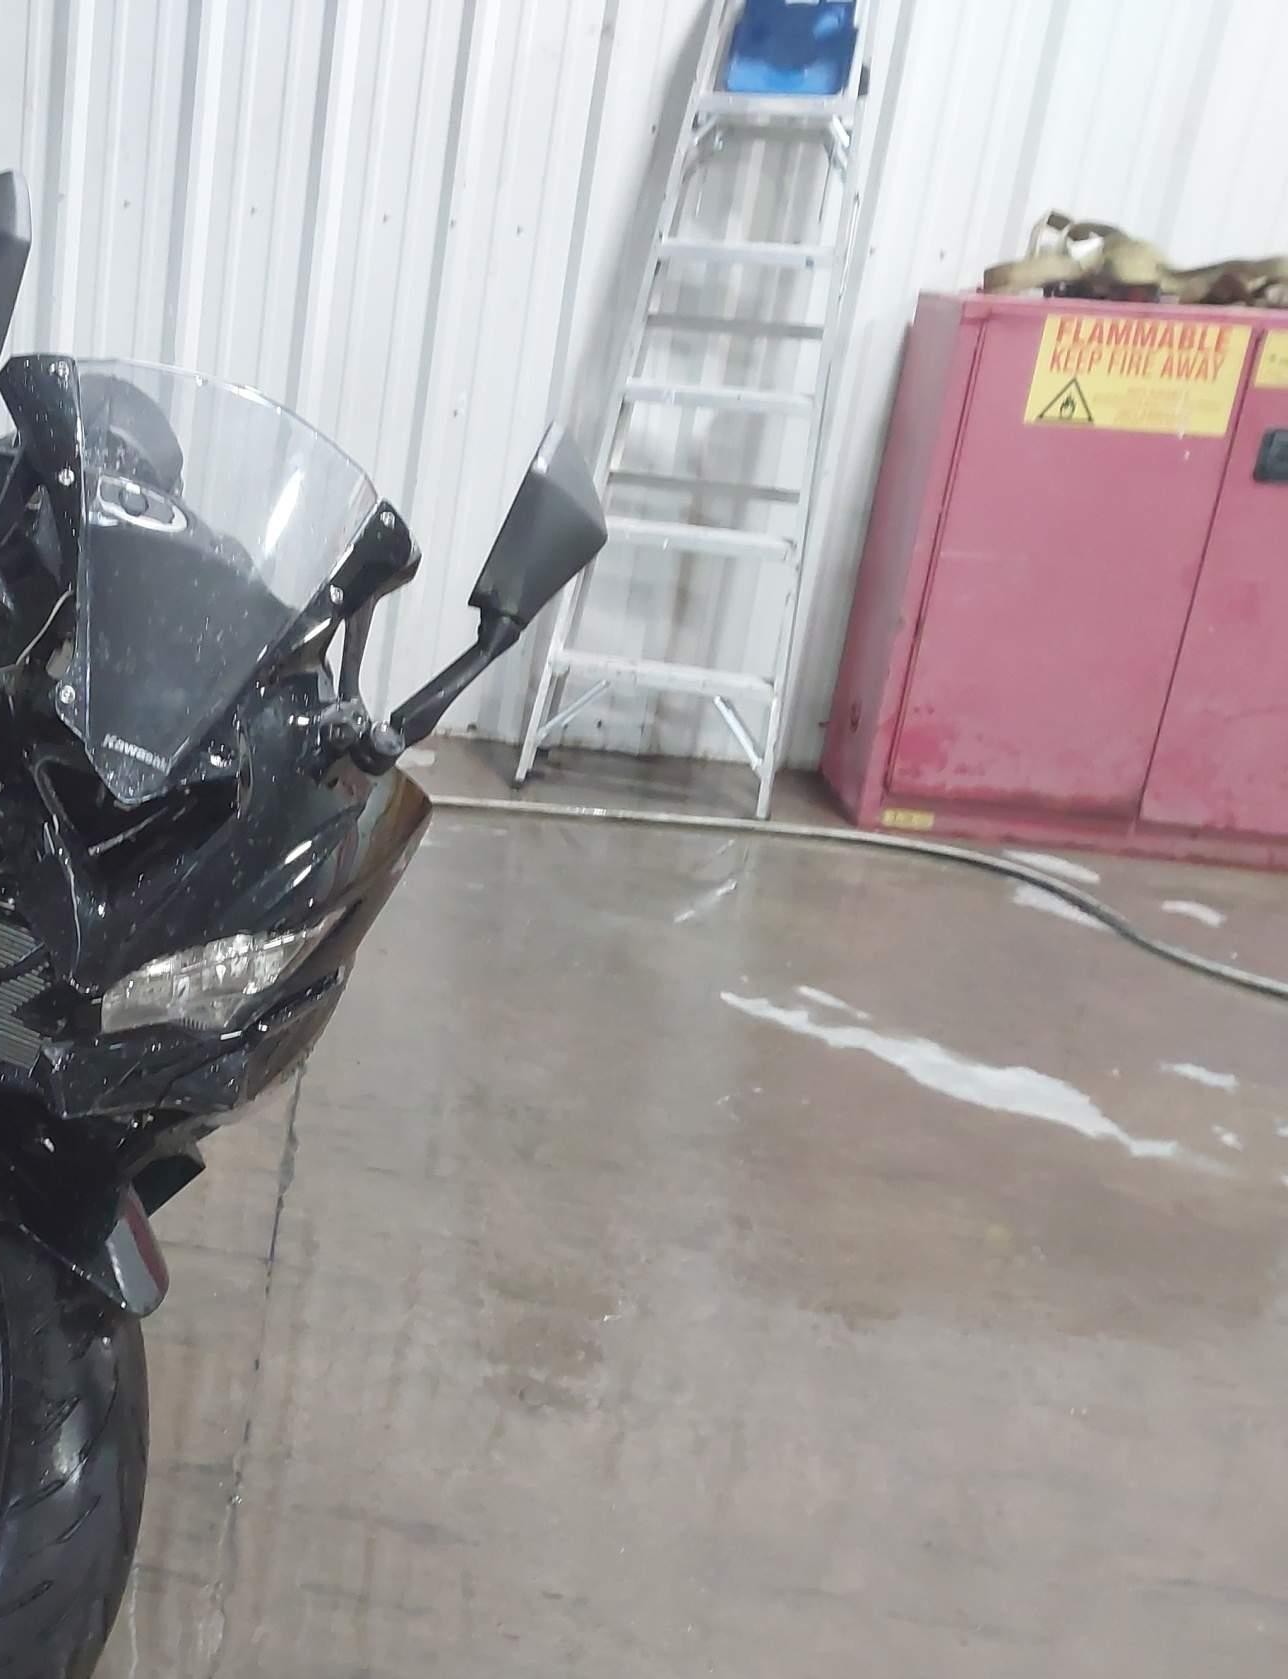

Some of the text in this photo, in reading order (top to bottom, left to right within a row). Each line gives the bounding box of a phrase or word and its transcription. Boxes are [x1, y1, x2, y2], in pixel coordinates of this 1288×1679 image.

[1056, 316, 1234, 353] FLAMMABLE
[1049, 347, 1102, 375] KEEP
[1107, 349, 1154, 378] FIRE
[1159, 352, 1226, 382] AWAY
